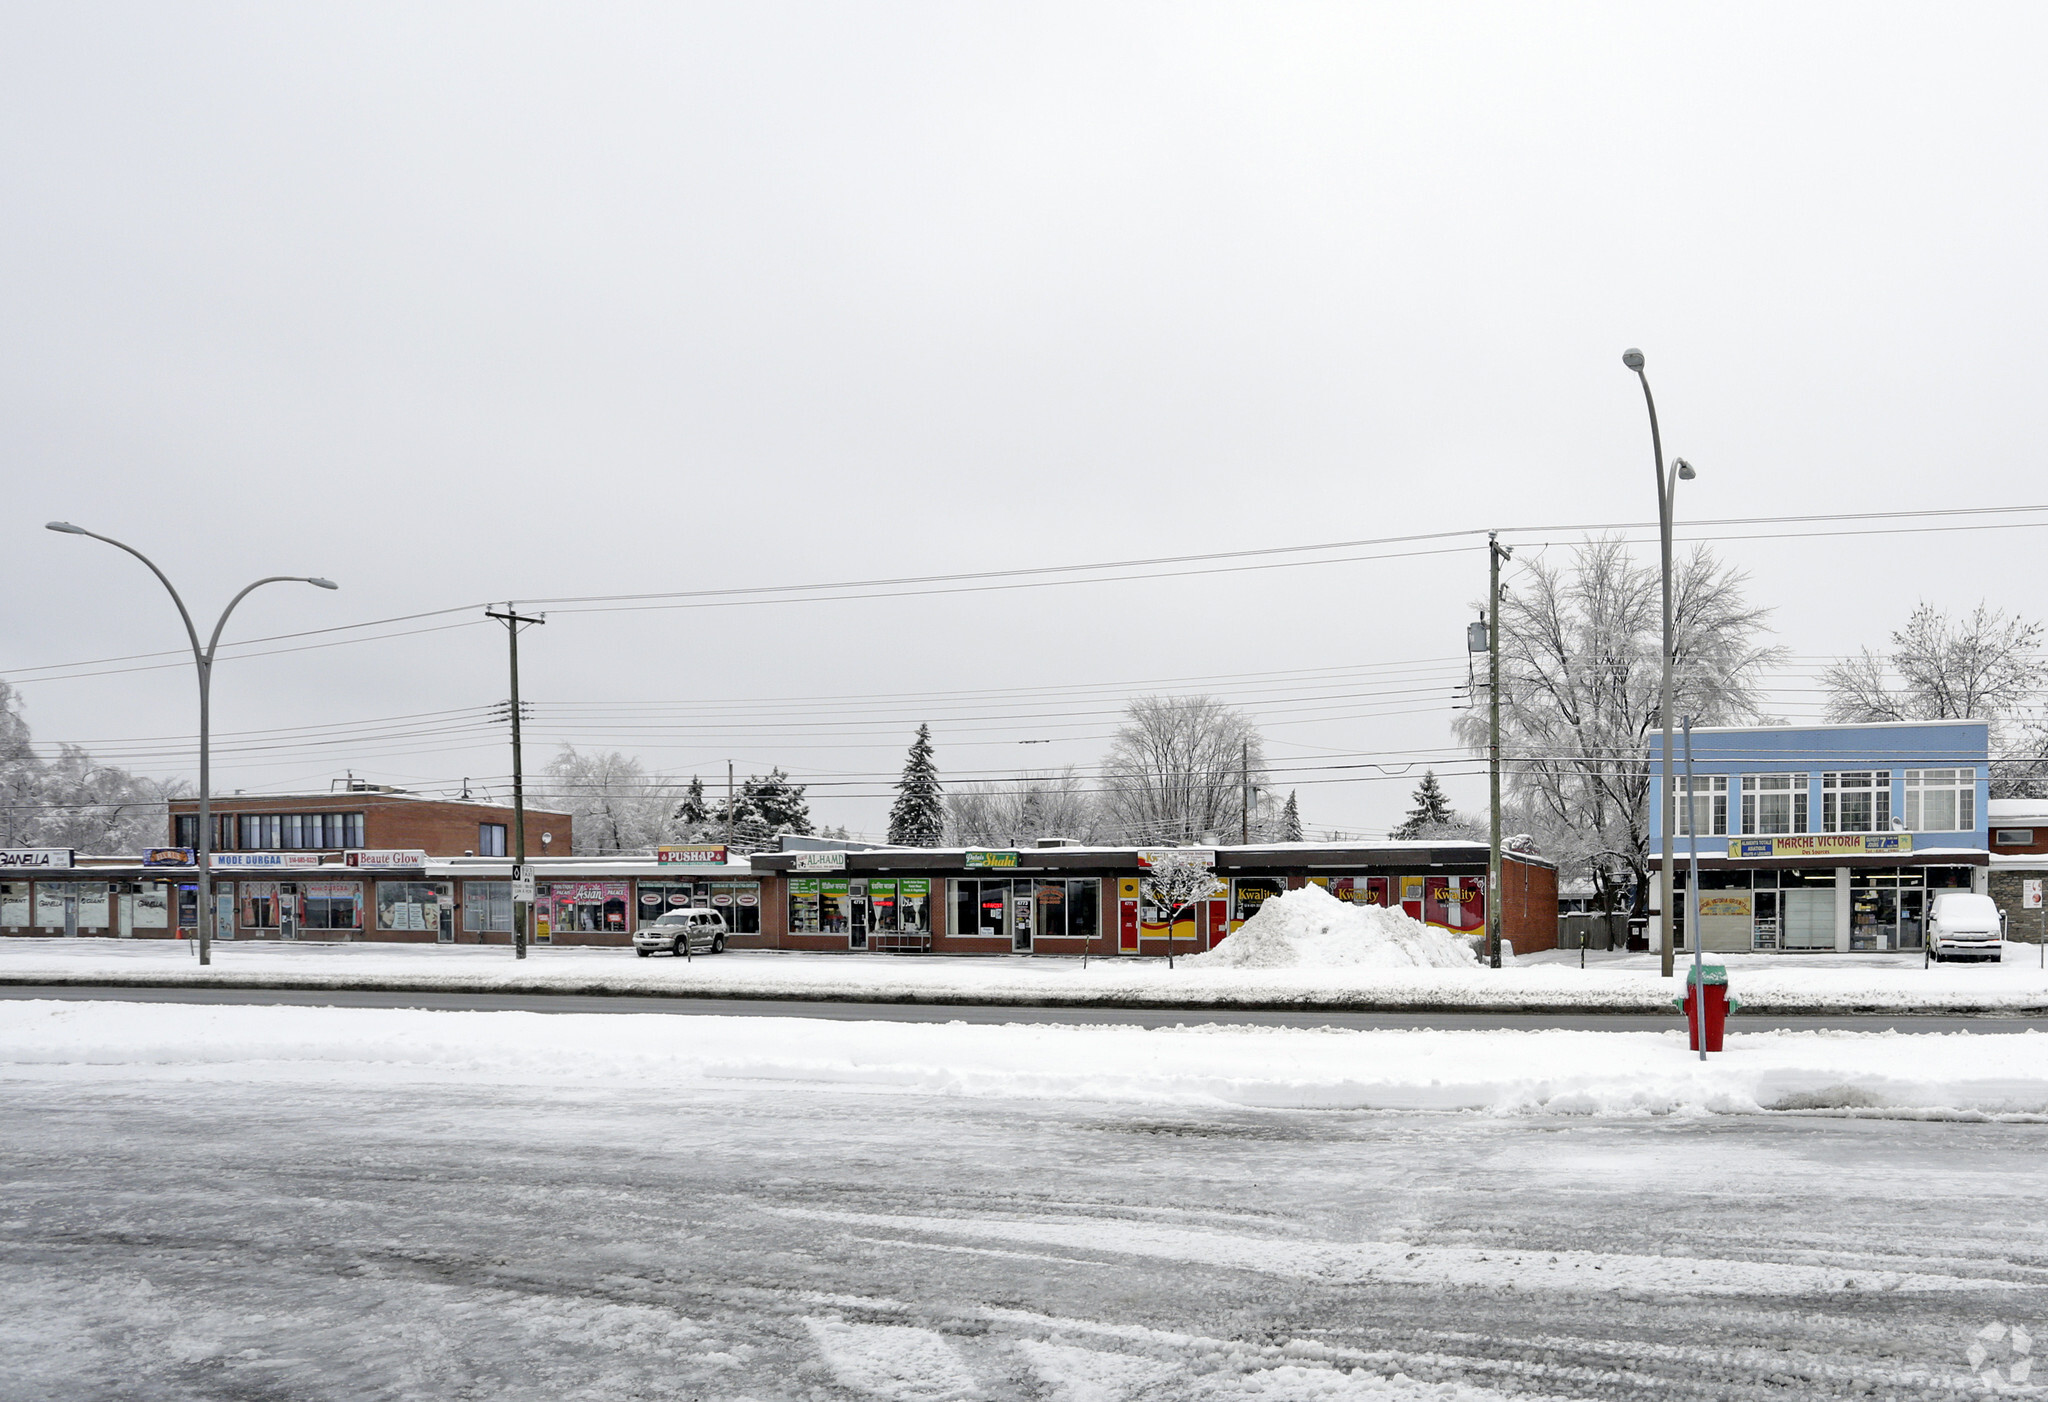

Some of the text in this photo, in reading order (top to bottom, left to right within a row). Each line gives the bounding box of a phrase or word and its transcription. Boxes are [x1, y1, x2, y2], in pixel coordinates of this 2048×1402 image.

[1777, 836, 1861, 849] MARCHE VICTORIA
[1880, 837, 1887, 848] 7
[218, 856, 281, 865] MODE DURGAA
[360, 852, 420, 864] Beauté Glow
[668, 851, 715, 862] PUSHAP
[808, 854, 844, 865] AL-HAMD
[983, 852, 1017, 867] Shahi
[573, 884, 604, 900] Asian
[1338, 888, 1380, 903] Kwality
[1434, 888, 1476, 902] Kwality
